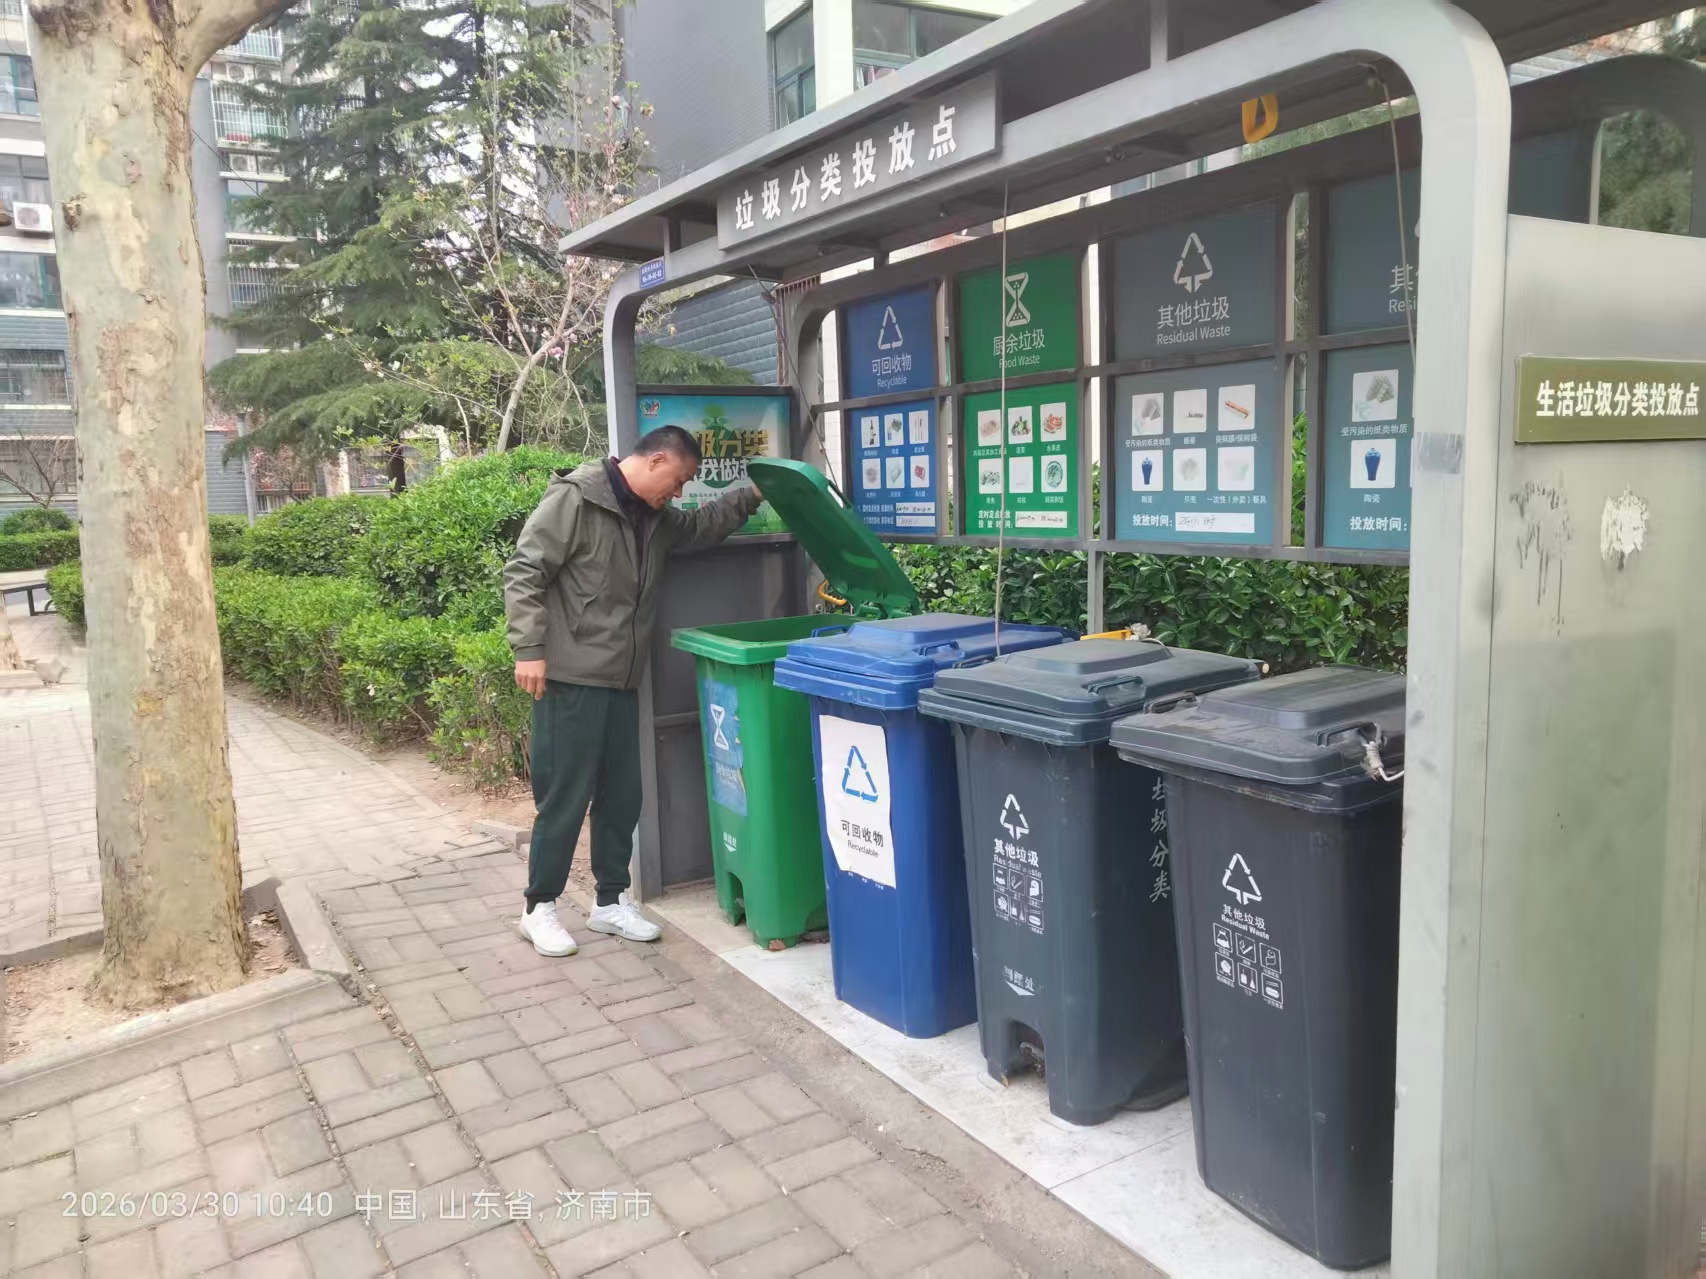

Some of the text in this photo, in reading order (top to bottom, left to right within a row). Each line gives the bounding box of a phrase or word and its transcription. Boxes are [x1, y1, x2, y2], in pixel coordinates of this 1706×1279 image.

[735, 105, 957, 230] 垃圾分类投放点
[1389, 264, 1419, 294] 其
[1157, 296, 1230, 330] 其他垃圾
[993, 328, 1045, 356] 厨余垃圾
[1157, 325, 1231, 346] Residual Waste
[871, 352, 912, 376] 可回收物
[1017, 354, 1041, 366] Waste
[877, 375, 907, 389] Recyclable
[1536, 380, 1700, 417] 生活垃圾分类投放点
[1341, 424, 1408, 437] 受污染的纸类物质
[693, 458, 752, 482] 我做
[1132, 513, 1173, 527] 投放时间：
[1349, 515, 1408, 532] 投放时间：
[840, 819, 884, 848] 可回收物
[847, 839, 879, 859] Recyclable
[994, 838, 1040, 868] 其他垃圾
[1221, 914, 1270, 940] Residual Waste
[1222, 904, 1266, 931] 其他垃圾
